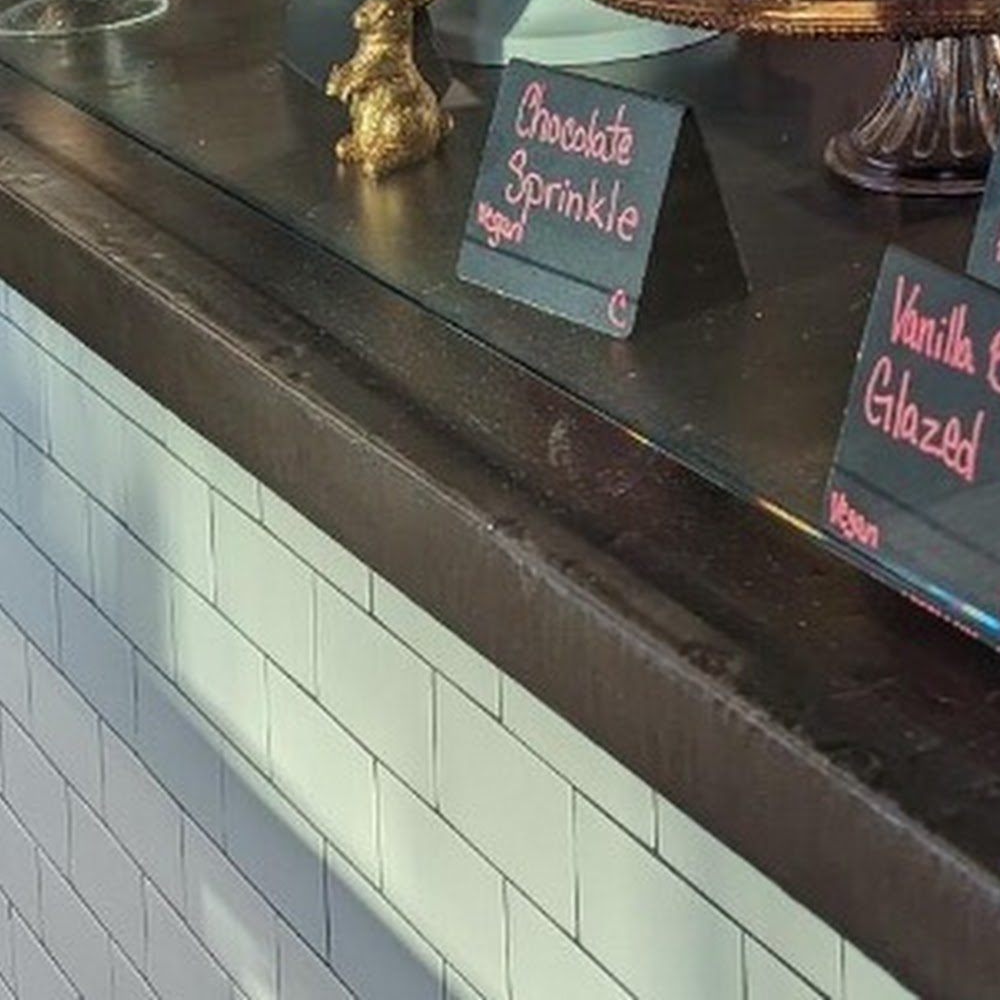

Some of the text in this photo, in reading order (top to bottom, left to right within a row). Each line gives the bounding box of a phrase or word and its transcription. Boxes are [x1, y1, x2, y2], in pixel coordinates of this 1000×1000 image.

[515, 80, 634, 167] Chocolate
[504, 147, 640, 243] Sprinkle
[606, 288, 628, 330] C
[890, 275, 976, 375] Vanilla
[863, 356, 985, 481] Glazed
